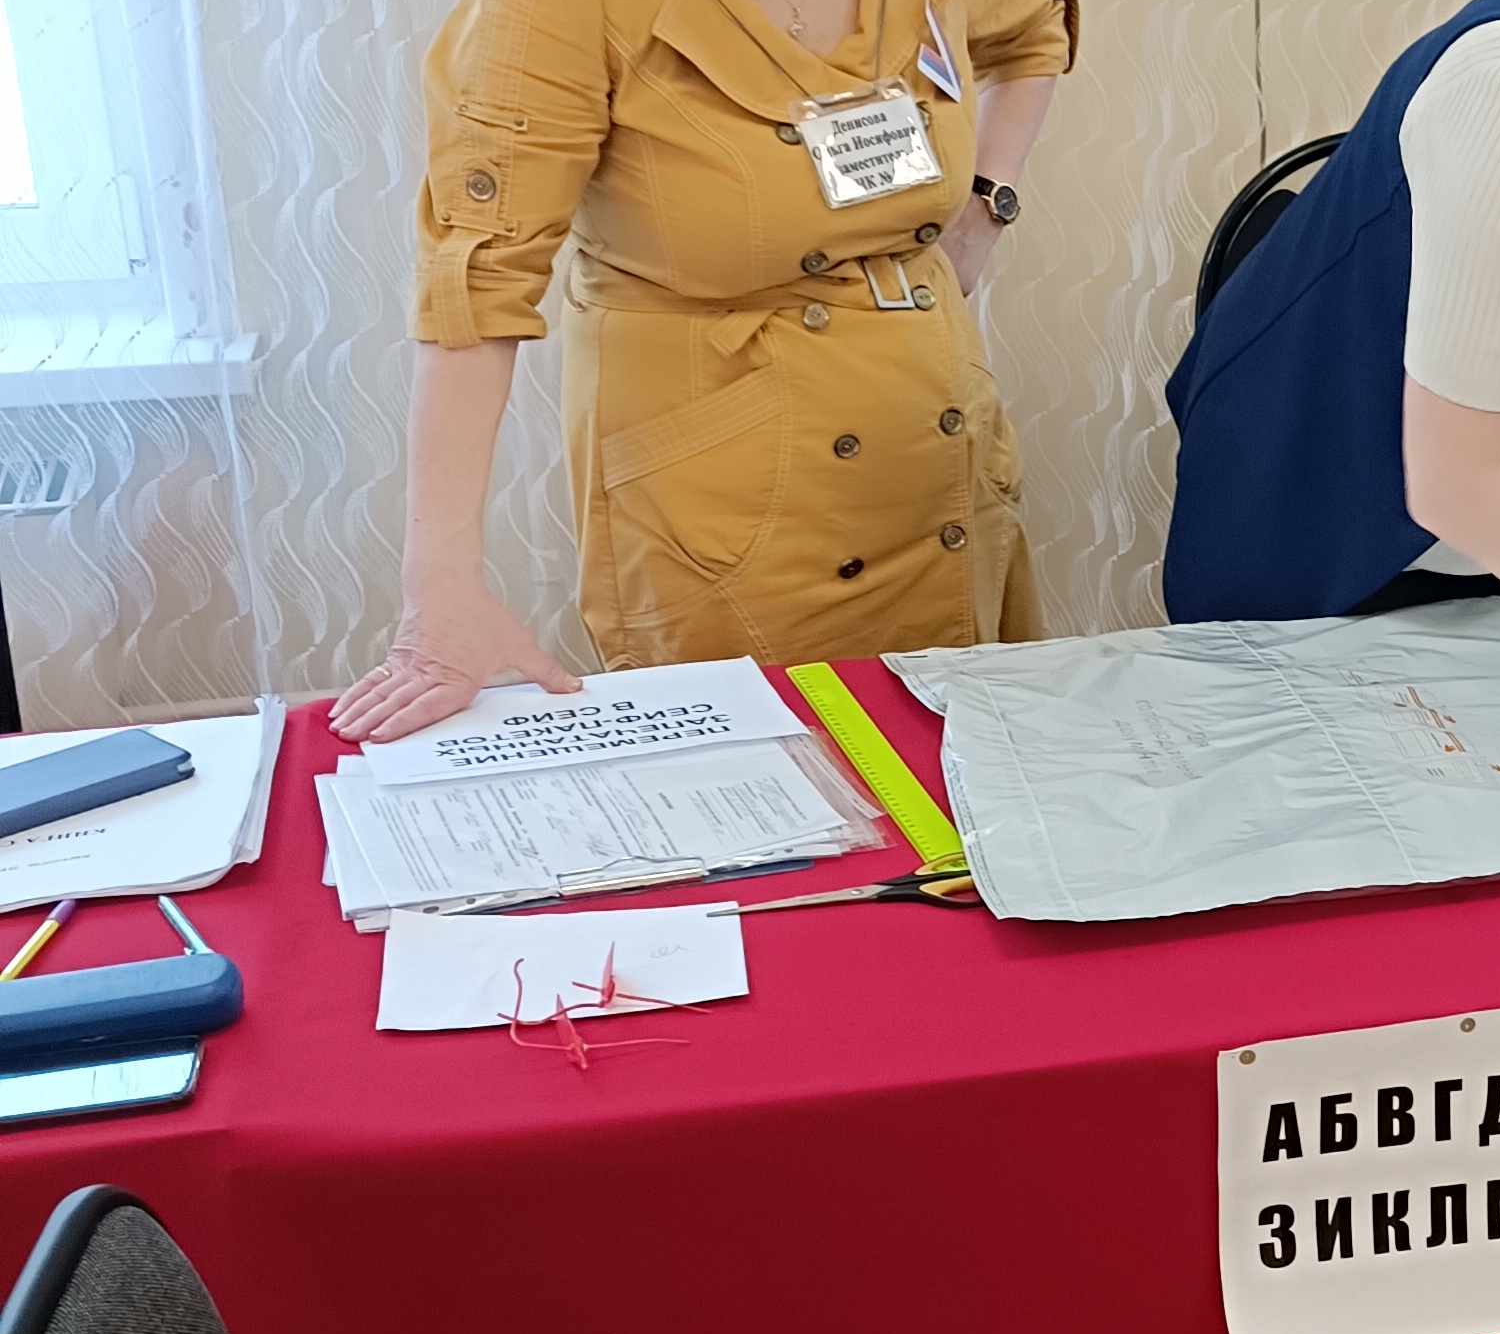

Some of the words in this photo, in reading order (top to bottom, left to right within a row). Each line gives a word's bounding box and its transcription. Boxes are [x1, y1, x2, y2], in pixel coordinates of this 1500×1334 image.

[830, 112, 888, 137] Денисова
[503, 706, 601, 726] СЕЙФ
[611, 701, 635, 712] В
[435, 713, 732, 757] ЗАПЕЧАТАННЫХ
[436, 703, 713, 747] СЕЙФ-ПАКЕТОВ
[449, 724, 731, 767] ПЕРЕМЕЩЕНИЕ
